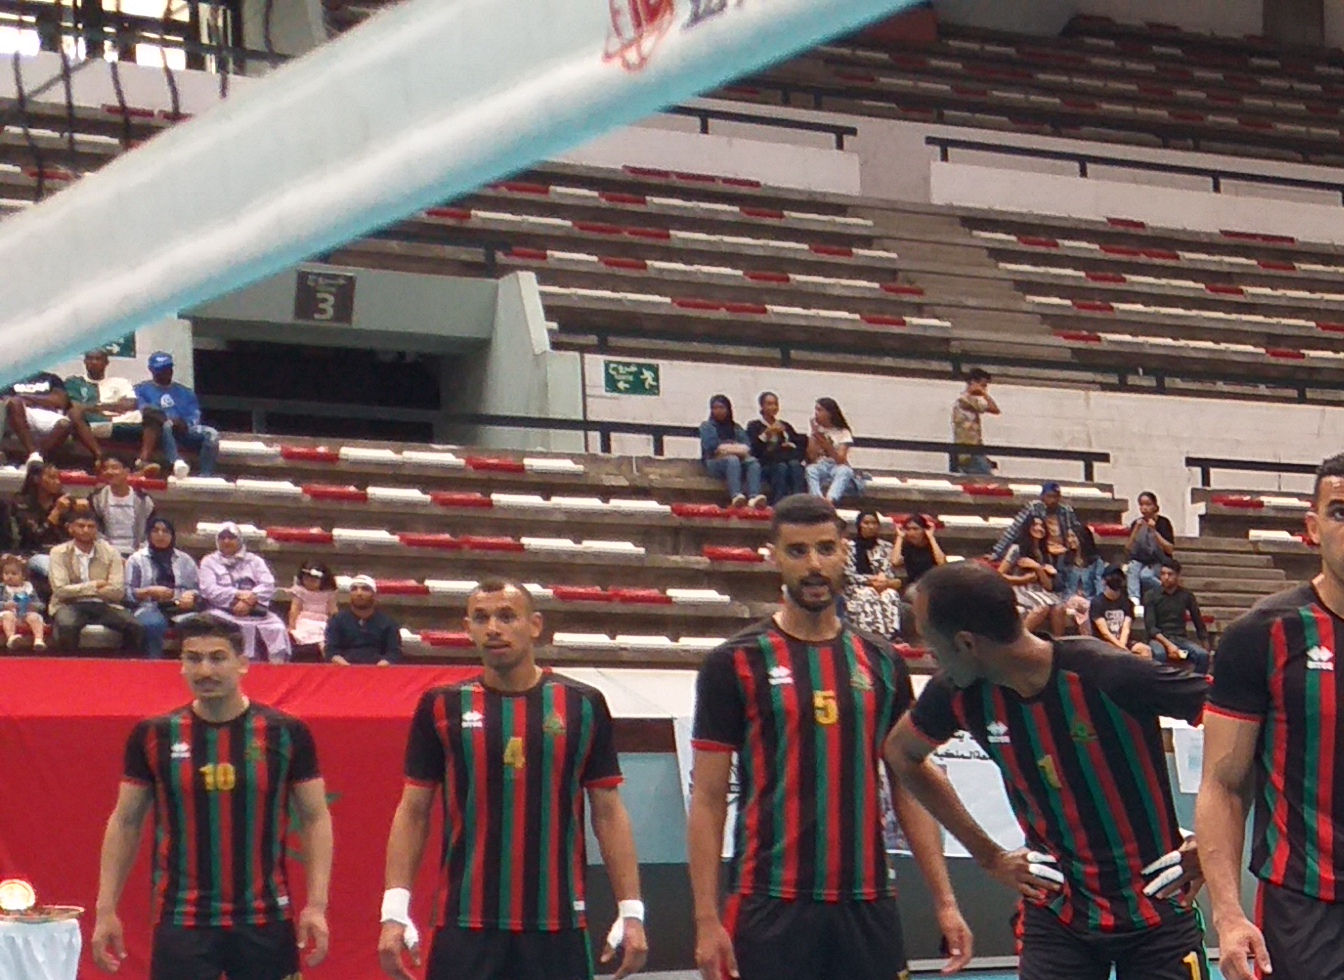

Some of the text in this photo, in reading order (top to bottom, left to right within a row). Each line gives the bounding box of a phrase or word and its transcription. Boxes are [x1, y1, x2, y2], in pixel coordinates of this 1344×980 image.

[313, 292, 335, 320] 3
[812, 690, 839, 725] 5
[503, 736, 526, 768] 4
[199, 762, 236, 791] 10
[1037, 754, 1062, 788] 1
